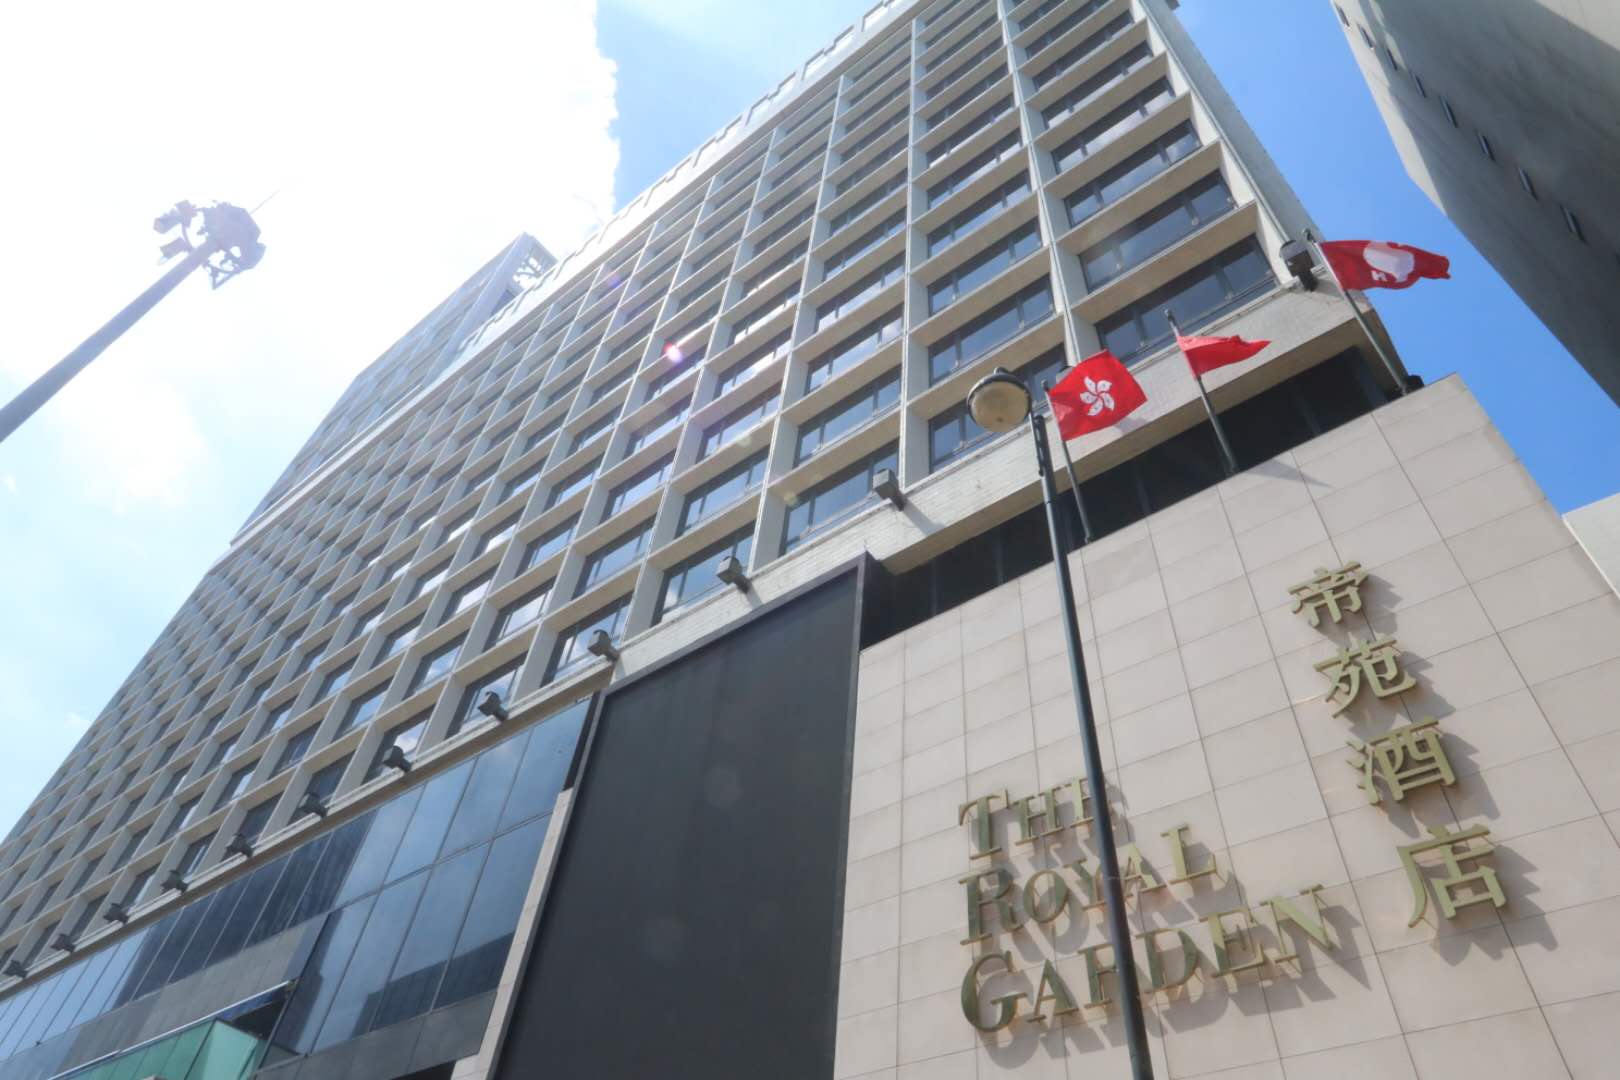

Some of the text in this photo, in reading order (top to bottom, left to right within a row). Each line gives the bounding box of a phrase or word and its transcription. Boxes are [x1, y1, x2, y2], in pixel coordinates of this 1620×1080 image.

[1288, 561, 1506, 928] 帝苑酒店
[959, 823, 1217, 945] ROYAL
